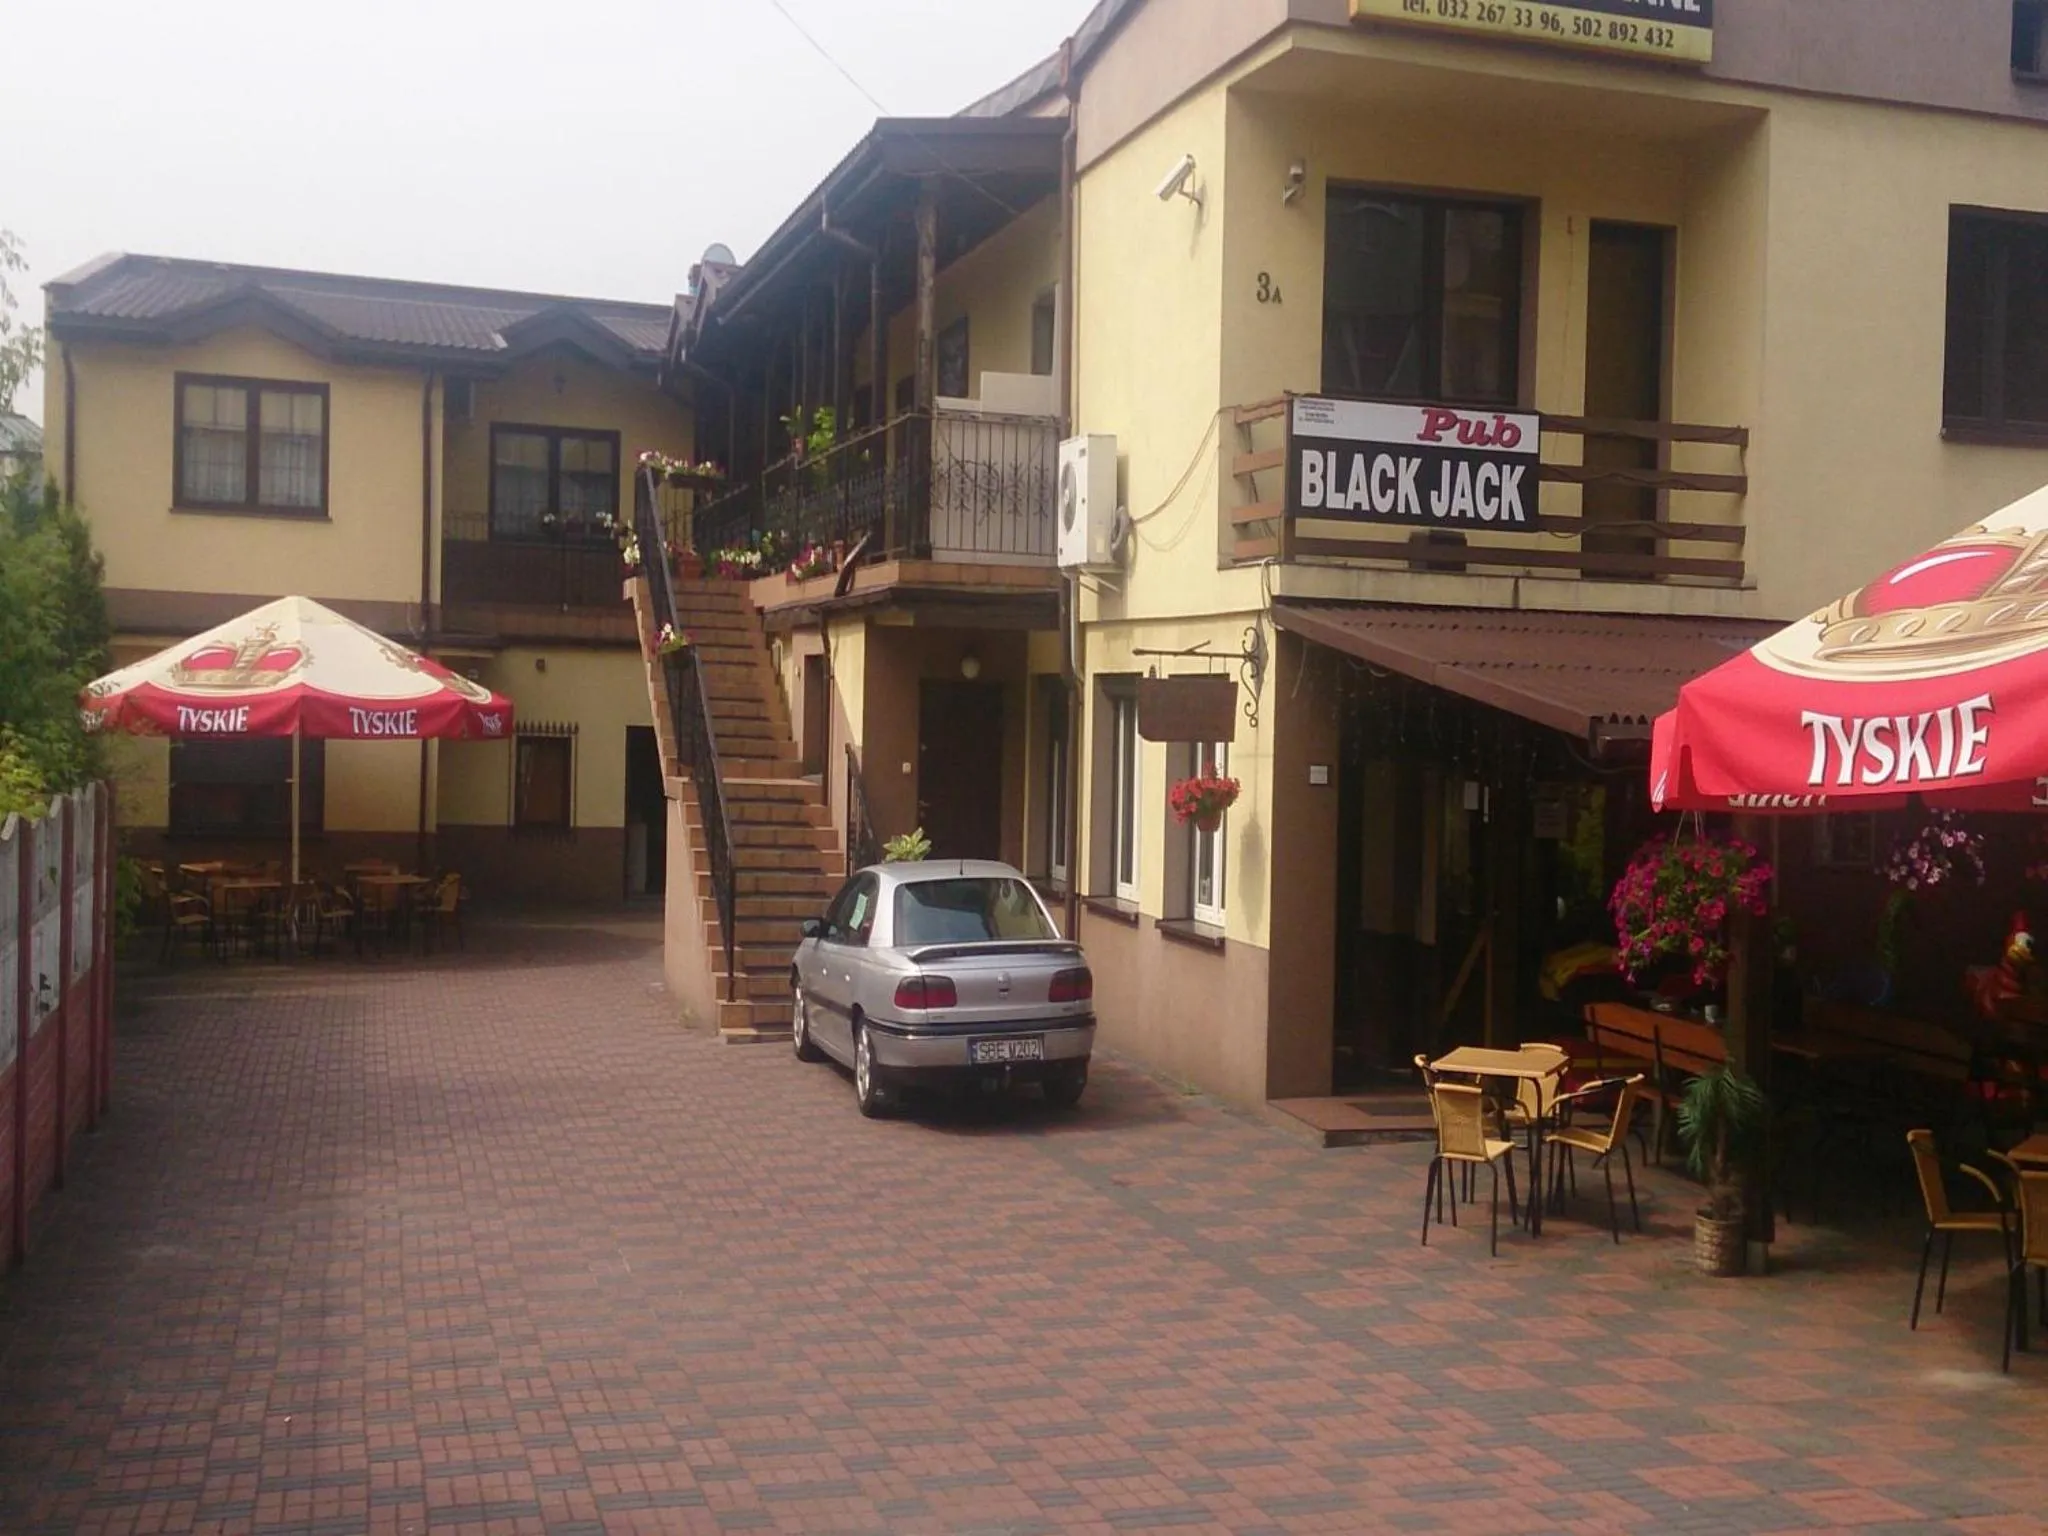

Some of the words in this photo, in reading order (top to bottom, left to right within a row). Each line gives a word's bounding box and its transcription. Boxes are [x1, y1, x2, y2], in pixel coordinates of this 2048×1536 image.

[1402, 0, 1431, 14] tel.
[1437, 0, 1469, 19] 032
[1476, 3, 1506, 24] 267
[1513, 7, 1533, 28] 33
[1540, 11, 1565, 36] 96,
[1572, 16, 1602, 38] 502
[1608, 21, 1638, 44] 892
[1644, 27, 1675, 48] 432
[1256, 271, 1283, 304] 3A
[1416, 407, 1522, 448] Pub
[1301, 449, 1422, 515] BLACK
[1430, 459, 1526, 522] JACK
[176, 704, 250, 733] TYSKIE
[348, 706, 418, 735] TYSKIE
[1801, 693, 1994, 787] TYSKIE
